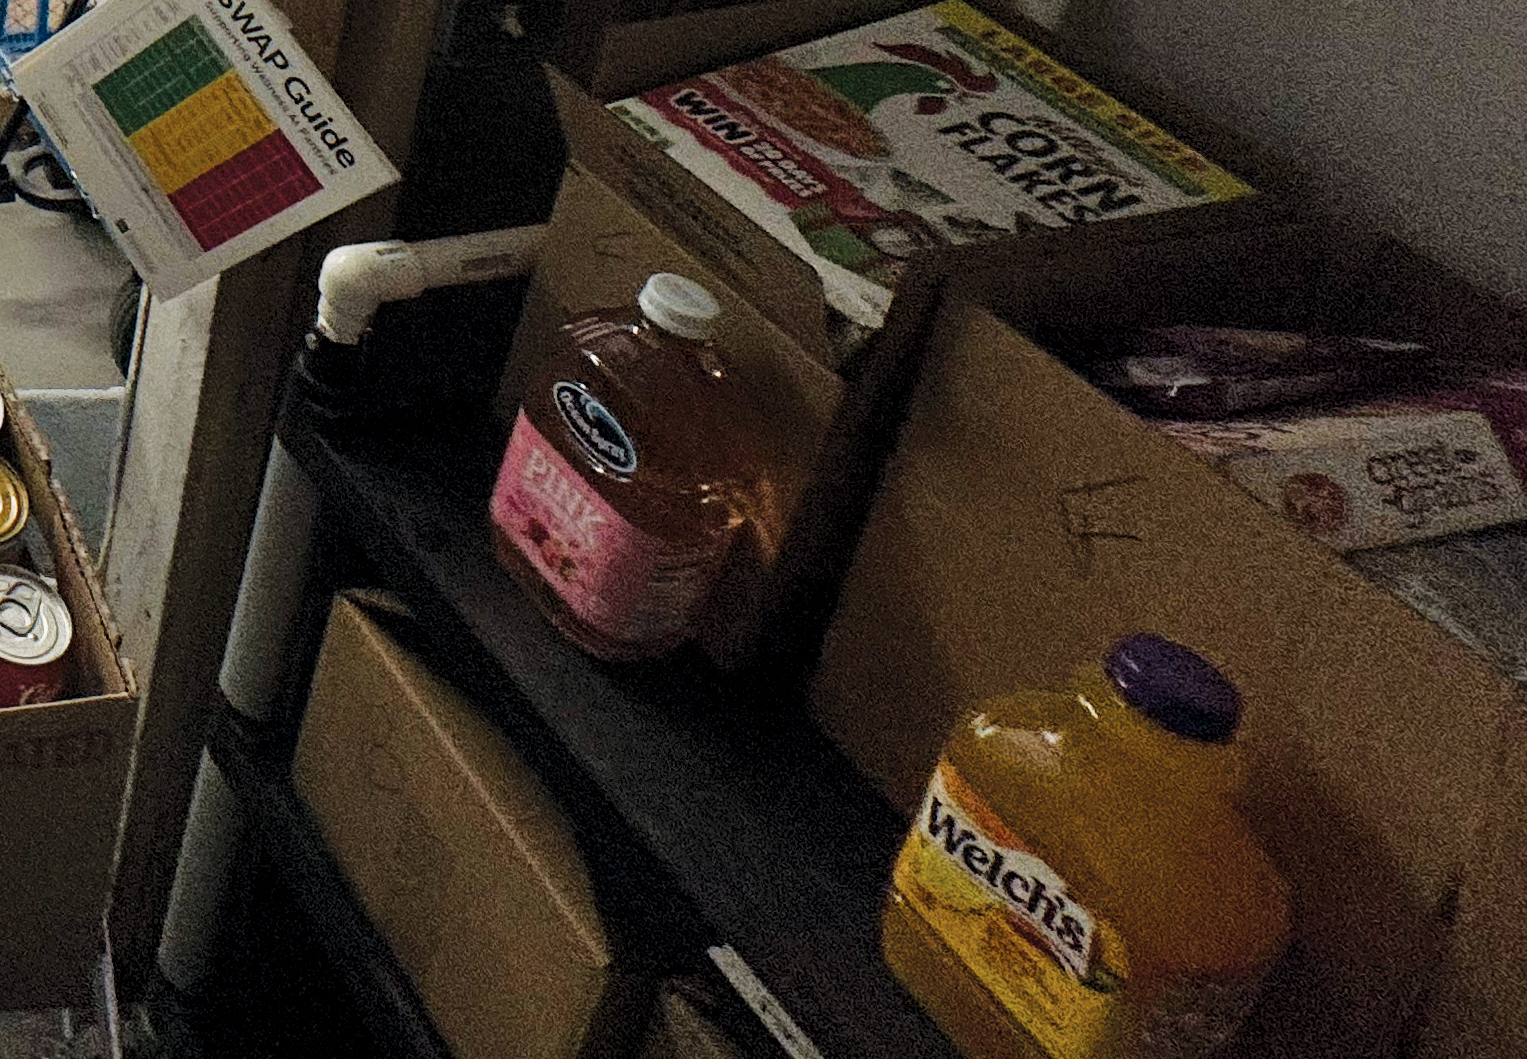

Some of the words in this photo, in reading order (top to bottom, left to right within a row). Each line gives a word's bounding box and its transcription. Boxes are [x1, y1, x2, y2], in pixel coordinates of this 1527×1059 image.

[284, 75, 357, 170] Guide
[674, 89, 752, 144] WIN
[976, 110, 1142, 218] CORN
[938, 118, 1101, 226] FLAKES
[927, 795, 1087, 955] Welch's
